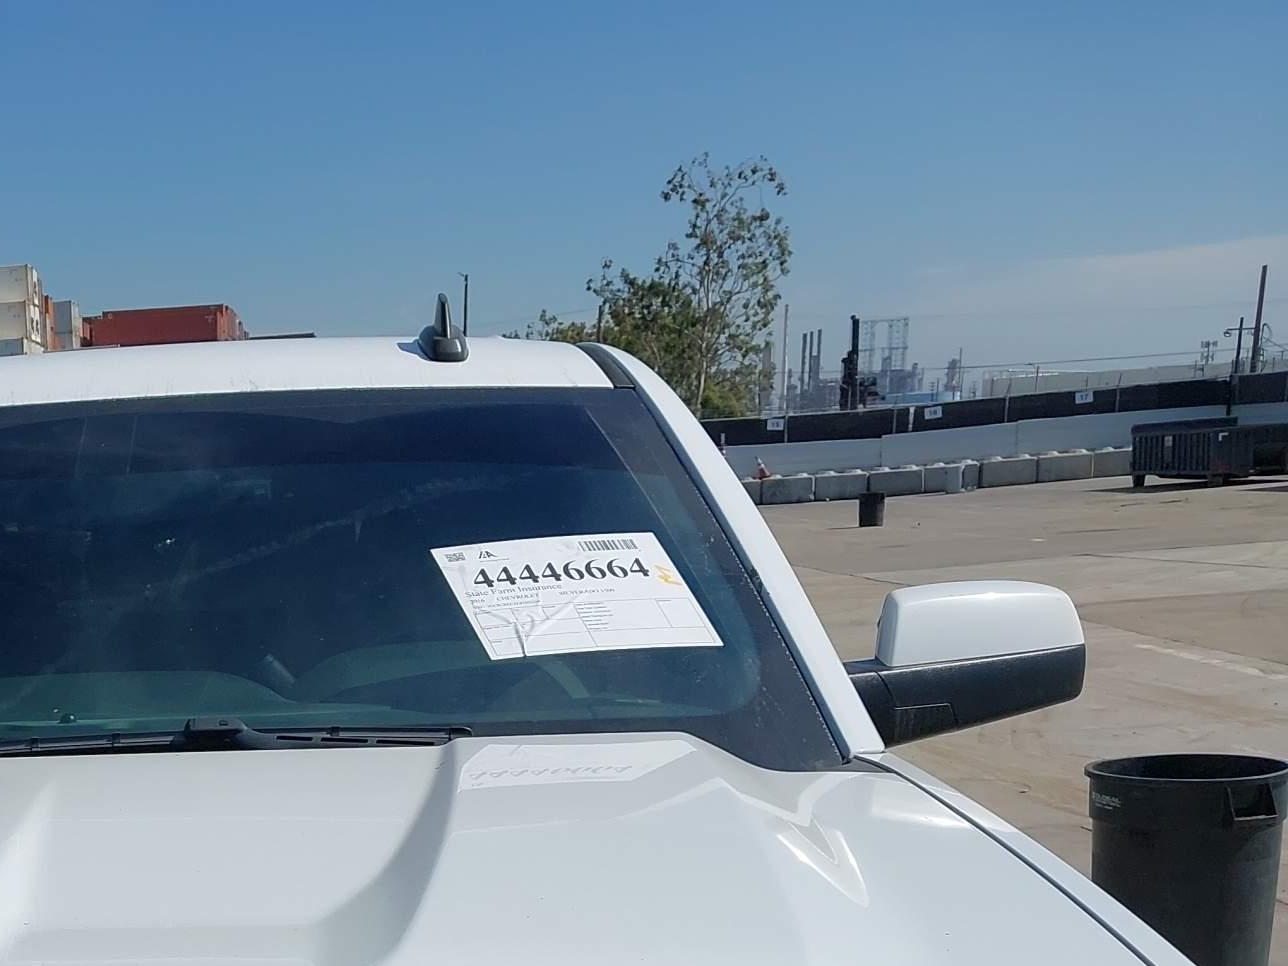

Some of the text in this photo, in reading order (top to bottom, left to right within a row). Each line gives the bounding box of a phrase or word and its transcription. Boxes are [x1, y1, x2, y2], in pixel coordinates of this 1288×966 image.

[474, 557, 650, 588] 44446664
[465, 584, 562, 598] State Farm Insurance
